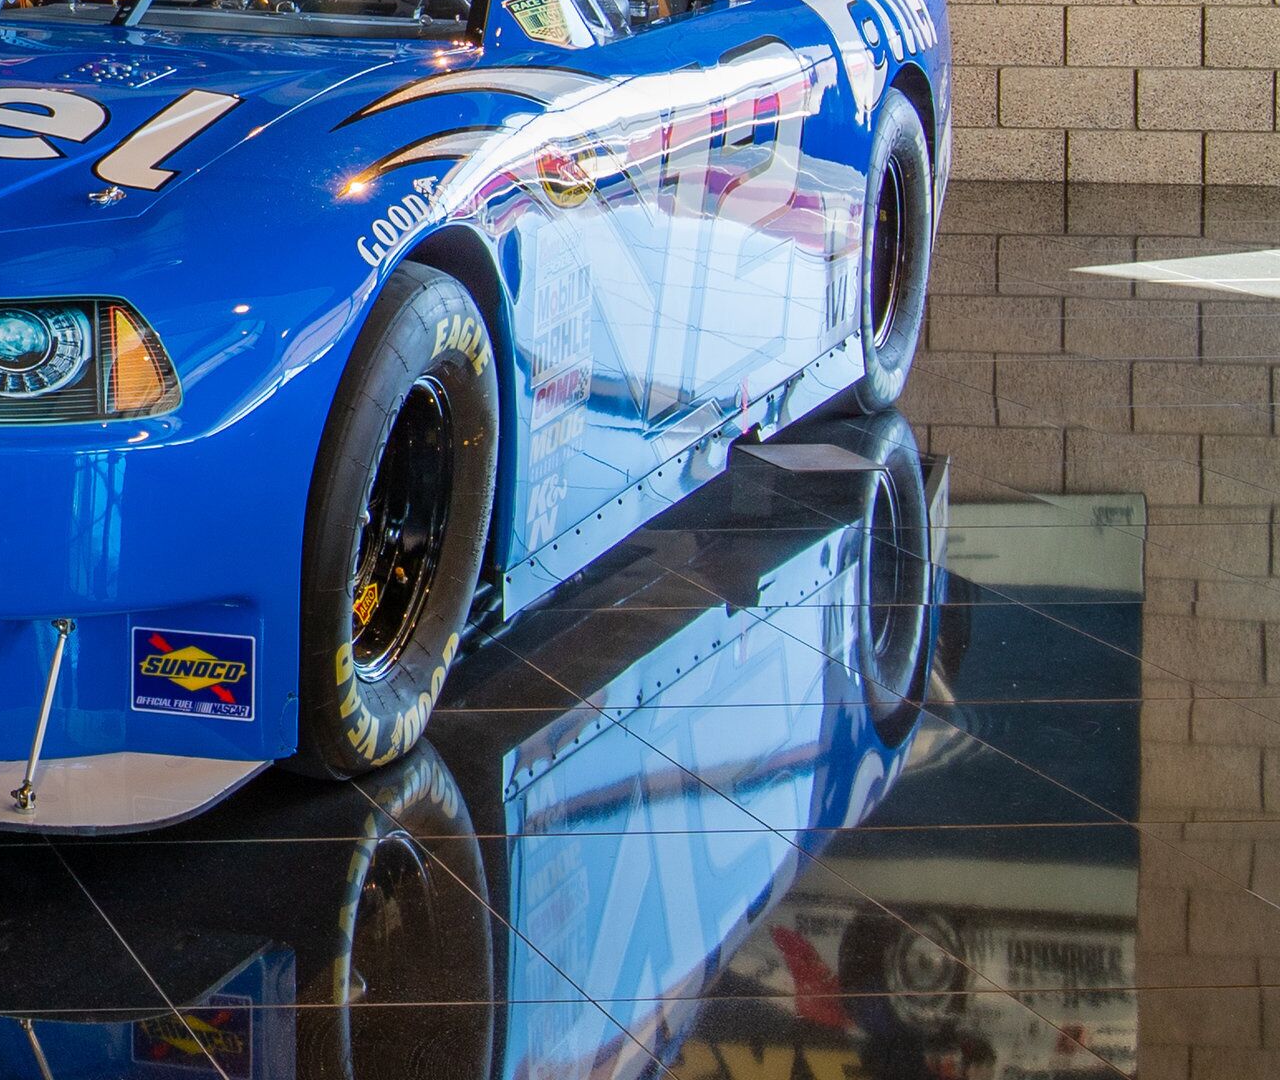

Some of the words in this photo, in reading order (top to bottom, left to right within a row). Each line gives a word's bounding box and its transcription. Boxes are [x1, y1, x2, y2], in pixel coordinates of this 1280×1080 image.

[430, 314, 491, 377] EAGLE
[531, 408, 586, 463] MOOG
[360, 589, 377, 617] AERO
[144, 657, 243, 681] SUNOCO
[137, 696, 172, 708] OFFICIAL
[173, 699, 194, 709] FUEL
[211, 702, 250, 716] NASCAR
